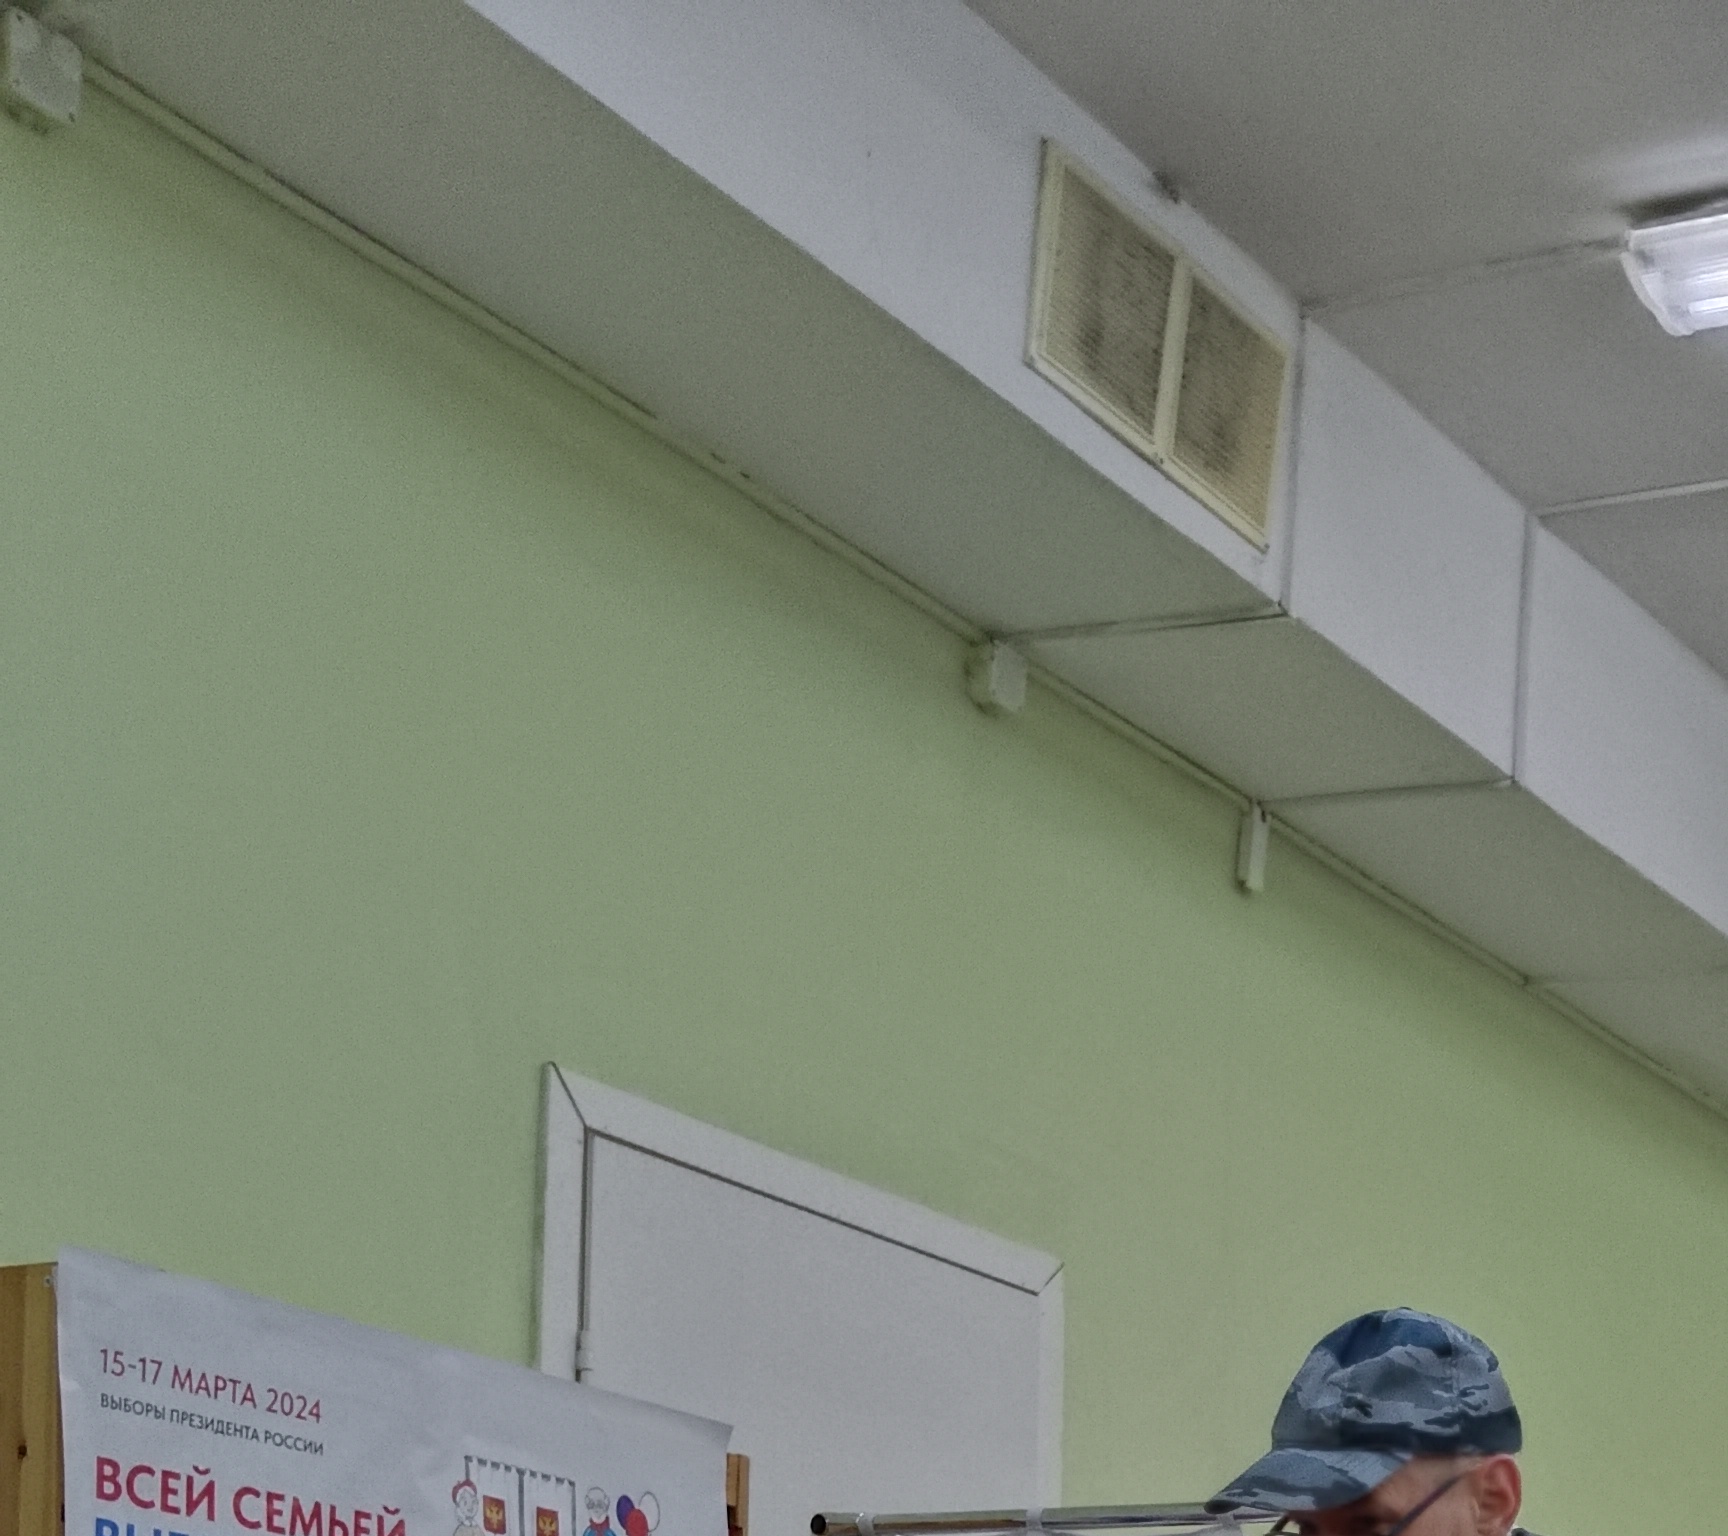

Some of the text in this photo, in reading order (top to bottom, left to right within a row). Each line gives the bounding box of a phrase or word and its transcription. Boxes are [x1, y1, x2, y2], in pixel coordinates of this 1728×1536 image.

[99, 1348, 323, 1425] 15-17 МАРТА 2024
[100, 1392, 325, 1457] ВЫБОРЫ ПРЕЗИДЕНТА РОССИИ
[95, 1455, 216, 1523] ВСЕЙ
